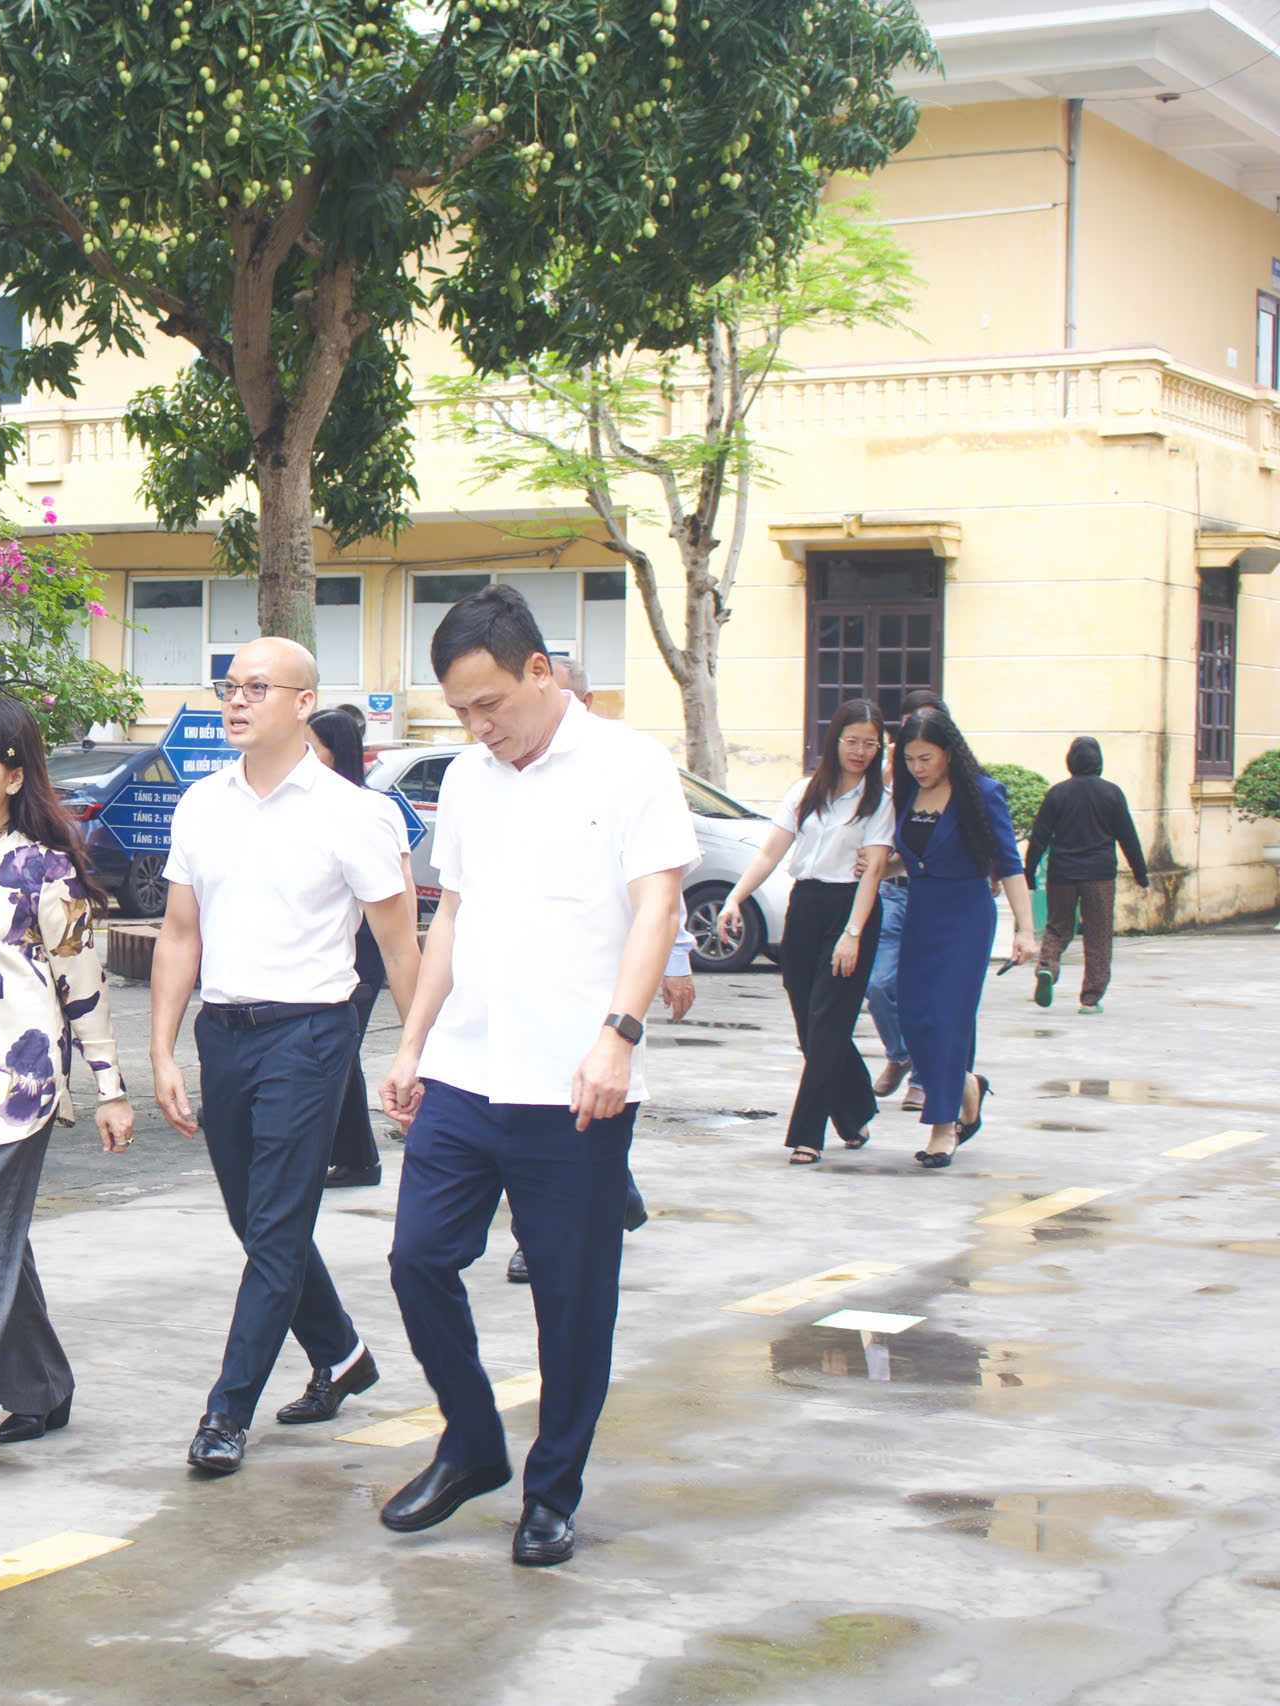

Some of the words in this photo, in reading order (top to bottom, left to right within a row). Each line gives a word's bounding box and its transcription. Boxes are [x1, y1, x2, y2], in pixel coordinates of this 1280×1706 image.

[154, 793, 161, 802] 3:
[154, 813, 162, 823] 2:
[154, 835, 161, 844] 1:
